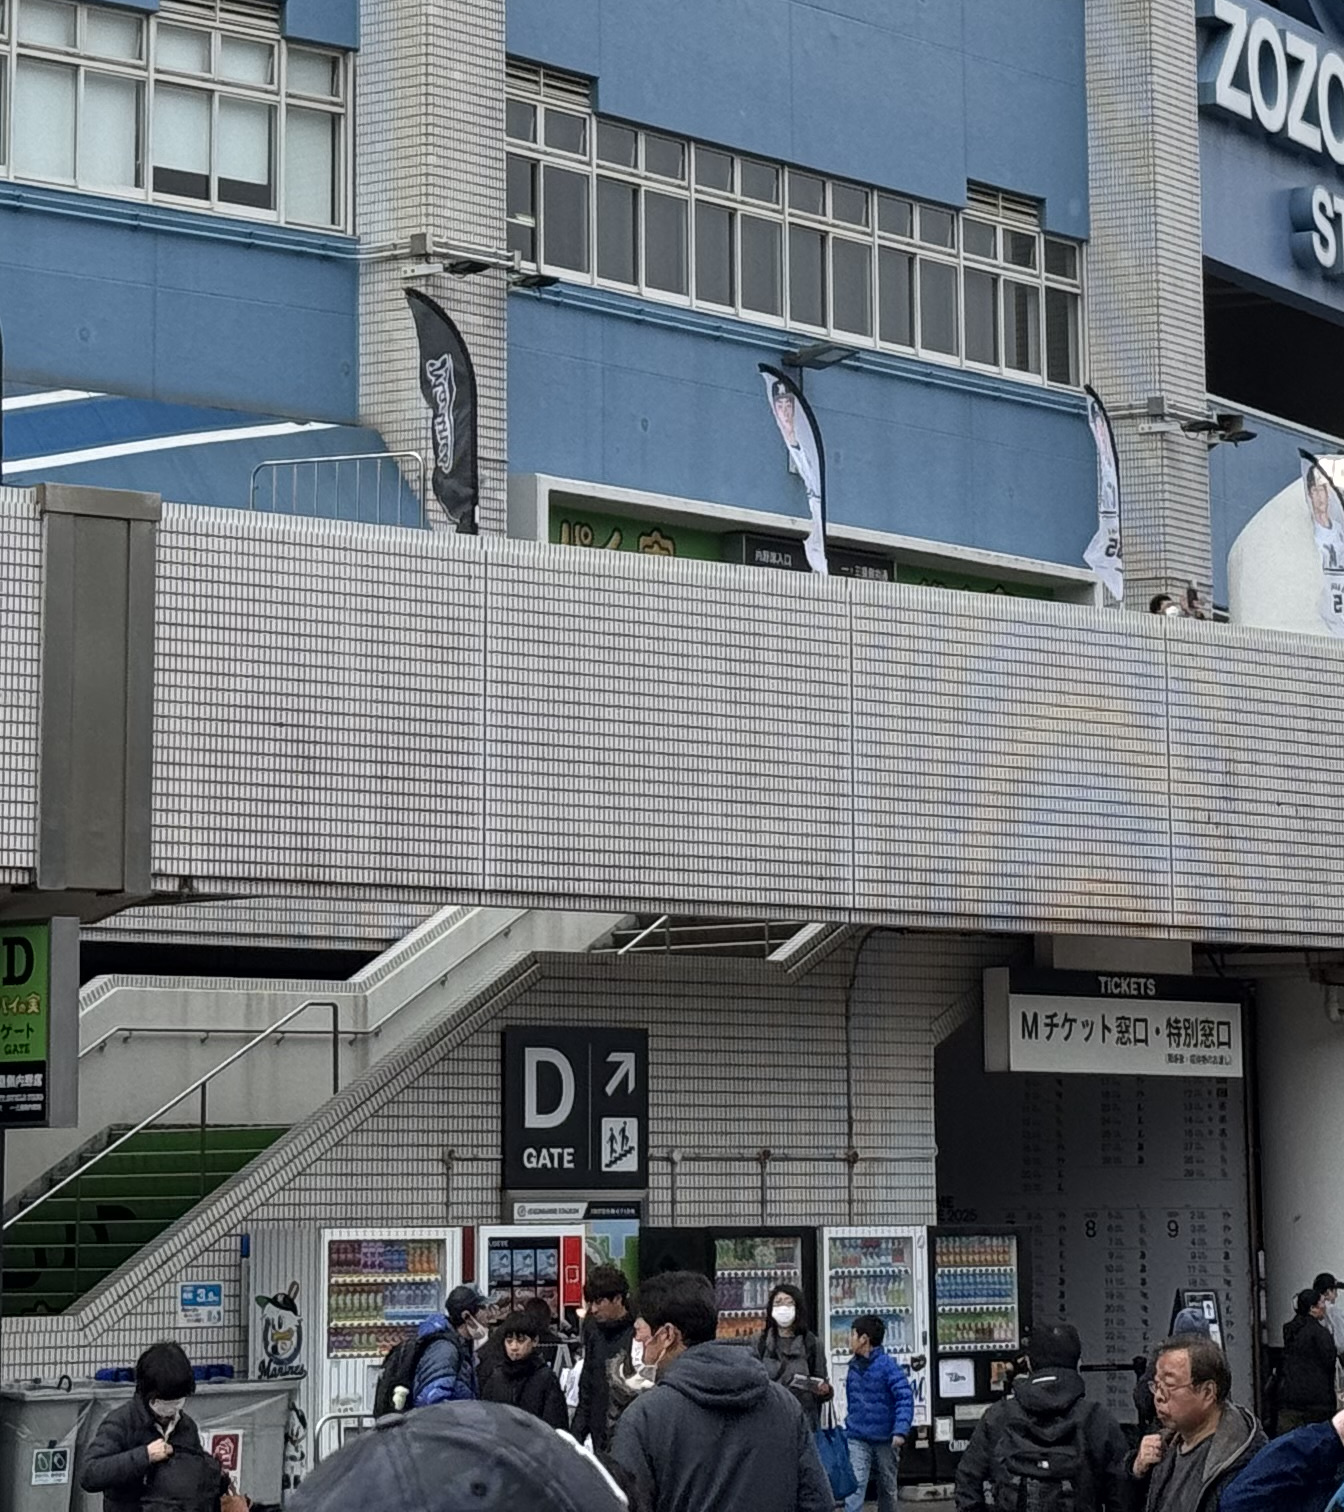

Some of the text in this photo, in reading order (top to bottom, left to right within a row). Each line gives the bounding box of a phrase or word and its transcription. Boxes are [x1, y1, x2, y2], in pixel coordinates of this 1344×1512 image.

[2, 937, 35, 986] D
[1098, 976, 1156, 996] TICKETS
[0, 1023, 34, 1039] ゲート
[4, 1044, 30, 1055] GATE
[523, 1046, 576, 1130] D
[523, 1147, 576, 1170] GATE
[1085, 1219, 1096, 1238] 8
[1166, 1219, 1179, 1238] 9
